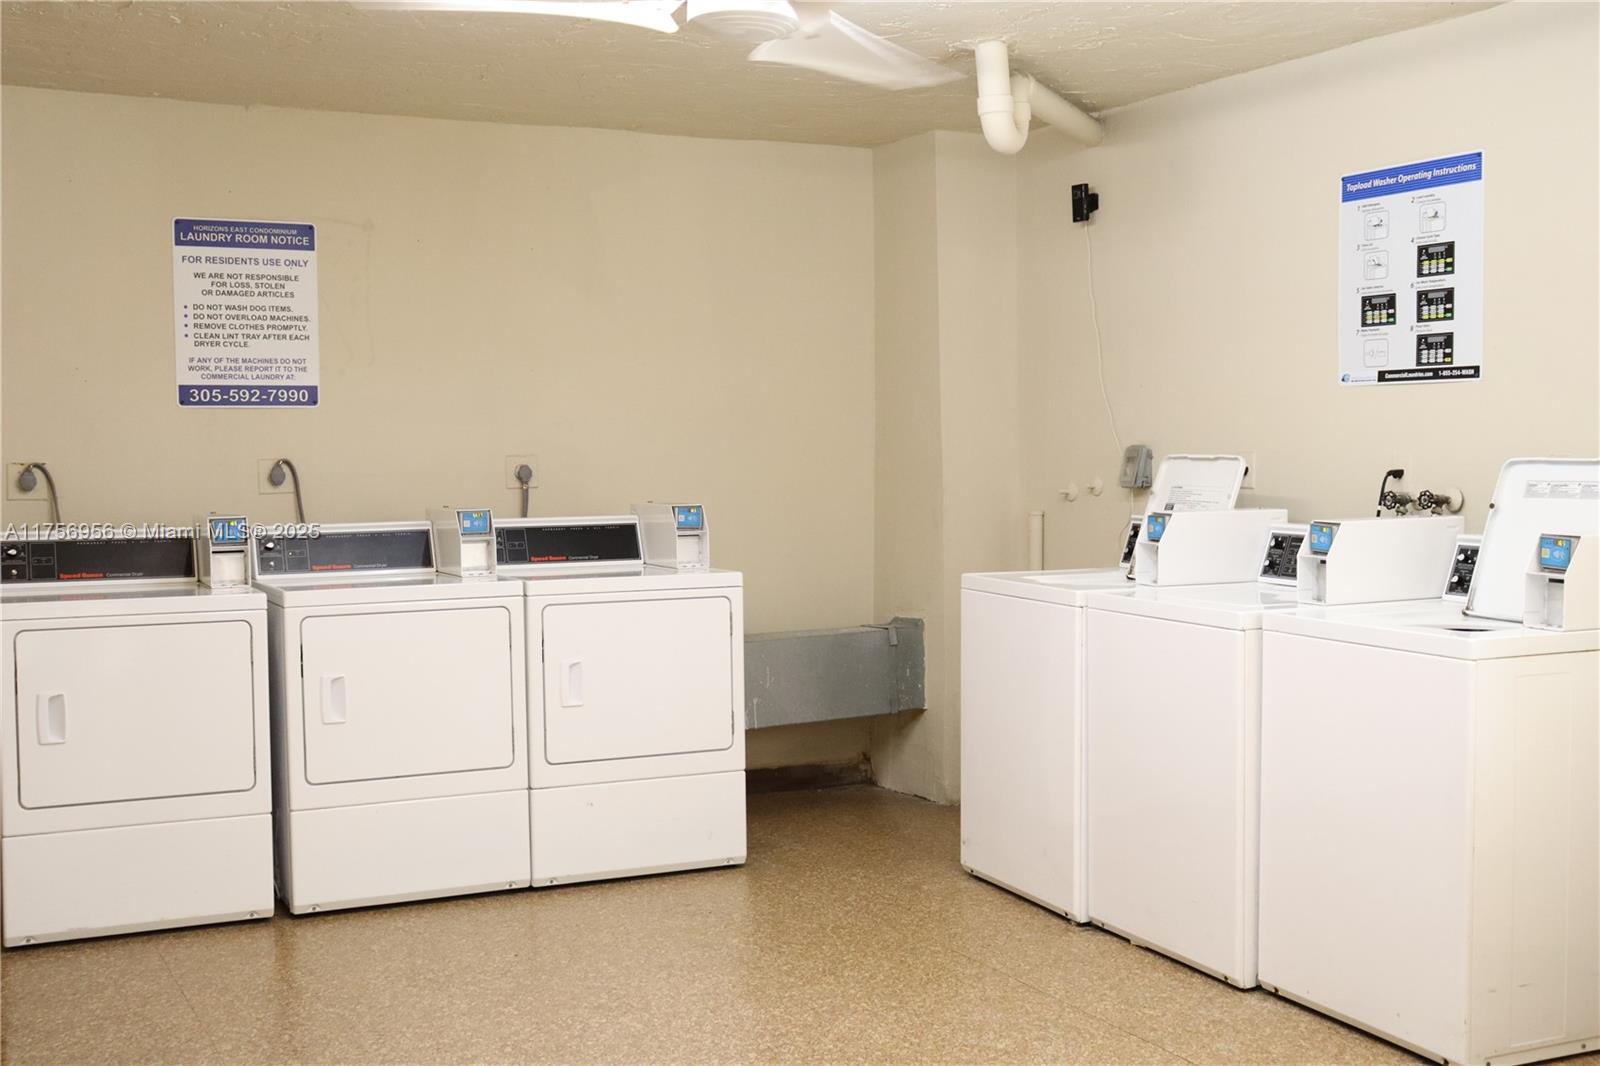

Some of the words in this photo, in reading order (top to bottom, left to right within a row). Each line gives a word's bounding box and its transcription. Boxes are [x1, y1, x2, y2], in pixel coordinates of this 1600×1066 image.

[1347, 180, 1372, 193] Topload
[1373, 176, 1397, 187] Washer
[1398, 169, 1432, 184] Operating
[1433, 163, 1477, 177] Instructions
[250, 227, 297, 235] CONDOMINIUM
[180, 232, 232, 242] LAUNDRY
[235, 234, 268, 244] ROOM
[271, 235, 310, 245] NOTICE
[182, 256, 202, 264] FOR
[205, 256, 260, 266] RESIDENTS
[262, 258, 281, 266] USE
[284, 259, 308, 267] ONLY
[245, 274, 299, 282] RESPONSIBLE
[190, 389, 309, 402] 305-592-7990
